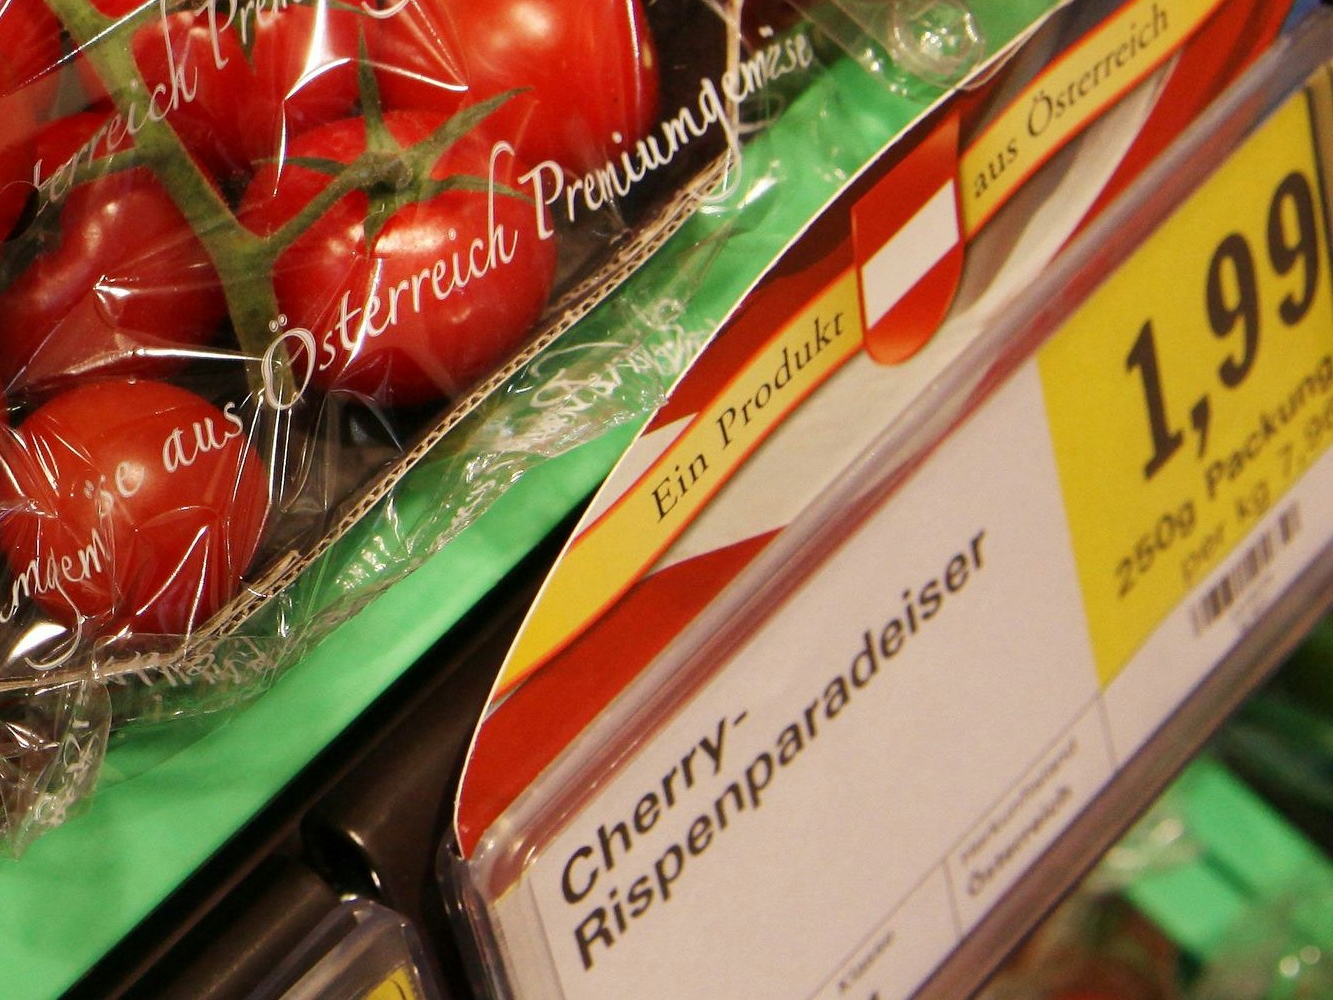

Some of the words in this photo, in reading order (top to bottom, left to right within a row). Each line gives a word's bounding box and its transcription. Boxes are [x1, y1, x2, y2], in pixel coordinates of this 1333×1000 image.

[971, 141, 1020, 201] aus
[1026, 4, 1171, 138] Österreich
[161, 400, 245, 474] aus
[262, 139, 522, 411] Österreich
[519, 24, 815, 242] Premiumgemüse
[1125, 169, 1320, 482] 1,99
[651, 453, 712, 523] Ein
[713, 310, 848, 450] Produkt
[1113, 500, 1199, 602] 250g
[559, 707, 749, 909] Cherry-
[570, 528, 989, 973] Rispenparadeiser
